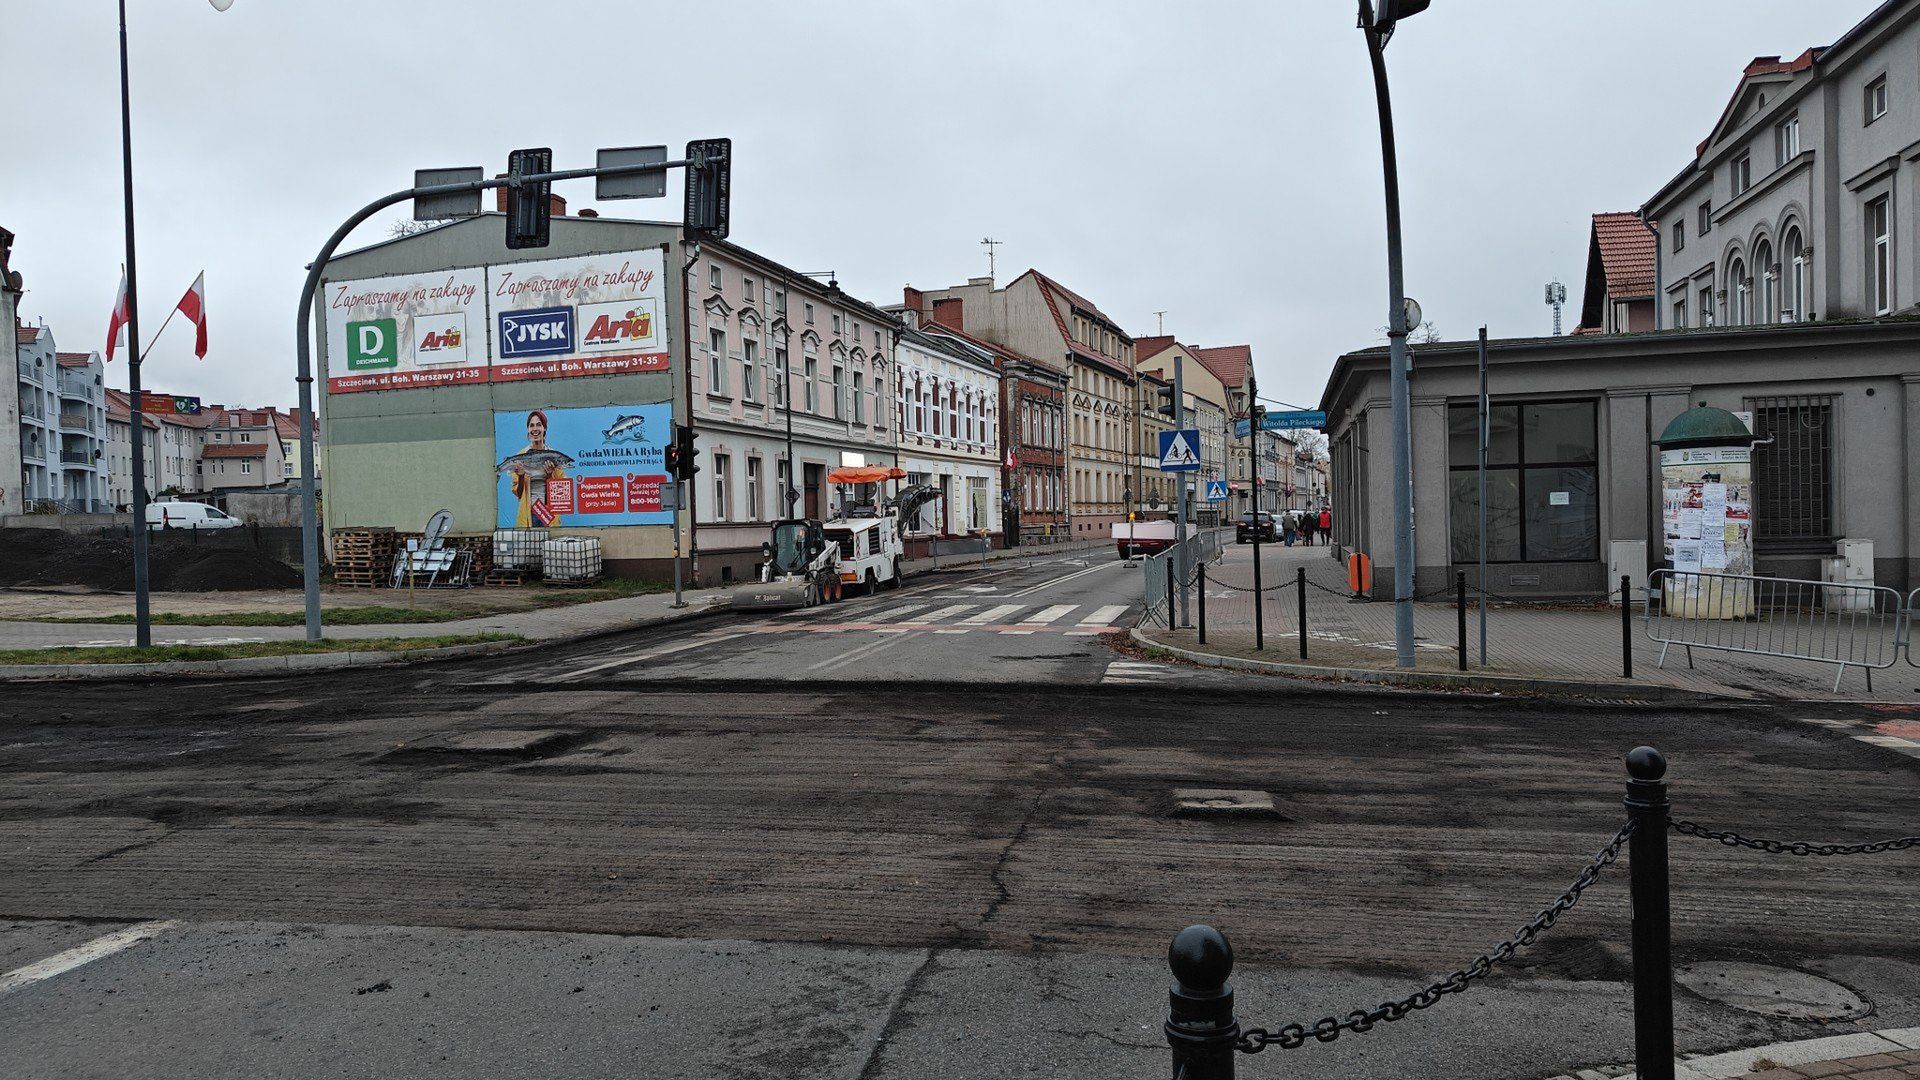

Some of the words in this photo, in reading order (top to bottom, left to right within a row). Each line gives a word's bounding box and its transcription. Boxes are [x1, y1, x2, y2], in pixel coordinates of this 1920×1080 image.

[496, 272, 579, 303] Zapraszamy
[583, 274, 599, 287] na
[602, 261, 654, 292] zakupy
[332, 286, 409, 315] Zapraszamy
[413, 288, 426, 300] na
[430, 276, 476, 305] zakupy
[517, 321, 566, 342] JYSK
[584, 310, 651, 339] Aria
[359, 325, 384, 356] D
[420, 328, 462, 349] Aria
[356, 357, 389, 366] DEICHMANN
[501, 366, 546, 376] Szczecinek,
[548, 363, 559, 372] ul.
[561, 362, 582, 371] Boh.
[583, 359, 630, 369] Warszawy
[632, 356, 658, 366] 31-35
[337, 378, 379, 388] Szczecinek,
[380, 376, 390, 385] ul.
[392, 375, 411, 384] Boh.
[412, 372, 455, 382] Warszawy
[456, 369, 480, 378] 31-35
[1290, 419, 1324, 427] Pileckiego
